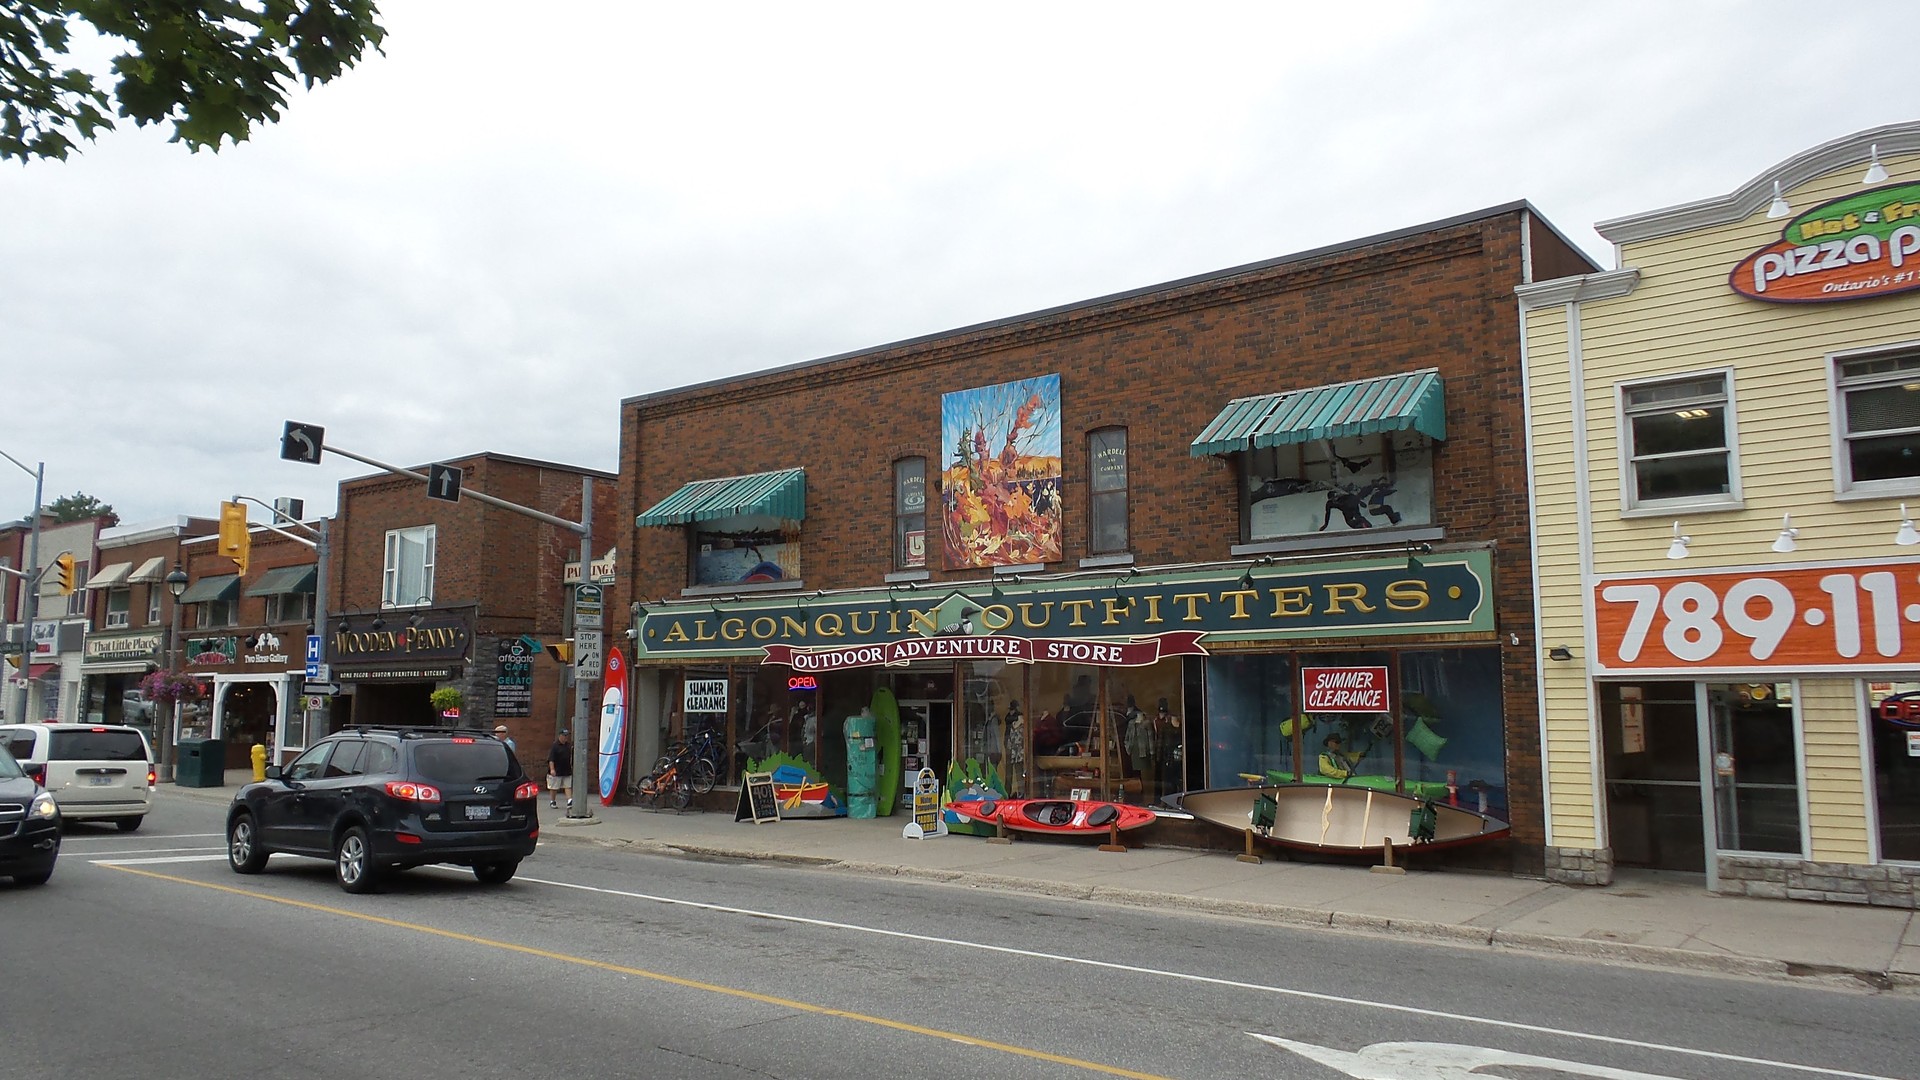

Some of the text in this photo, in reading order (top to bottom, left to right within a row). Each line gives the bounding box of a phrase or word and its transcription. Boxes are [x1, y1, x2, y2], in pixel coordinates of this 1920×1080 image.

[1800, 212, 1861, 240] Hot
[1822, 271, 1914, 293] Ontario's #1
[567, 565, 609, 579] PAING
[980, 579, 1430, 630] OUTFITTERS
[662, 607, 942, 643] ALGONQUIN
[335, 626, 459, 656] WOODEN PENNY
[580, 633, 596, 641] STOP
[94, 640, 111, 652] That
[112, 639, 133, 651] Little
[308, 640, 319, 659] H
[579, 642, 597, 650] HERE
[244, 653, 288, 664] Two Horse Gallery
[498, 654, 534, 664] affogato
[794, 638, 1123, 670] OUTDOOR ADVENTURE STORE
[504, 663, 529, 671] CAFE
[580, 669, 599, 677] SIGNAL
[498, 677, 532, 685] GELATO
[788, 676, 816, 688] OPEN
[1315, 671, 1374, 689] SUMMER
[689, 682, 724, 696] SUMMER
[686, 696, 726, 710] CLEARANCE
[1309, 689, 1383, 707] CLEARANCE
[917, 814, 936, 823] PADDLE
